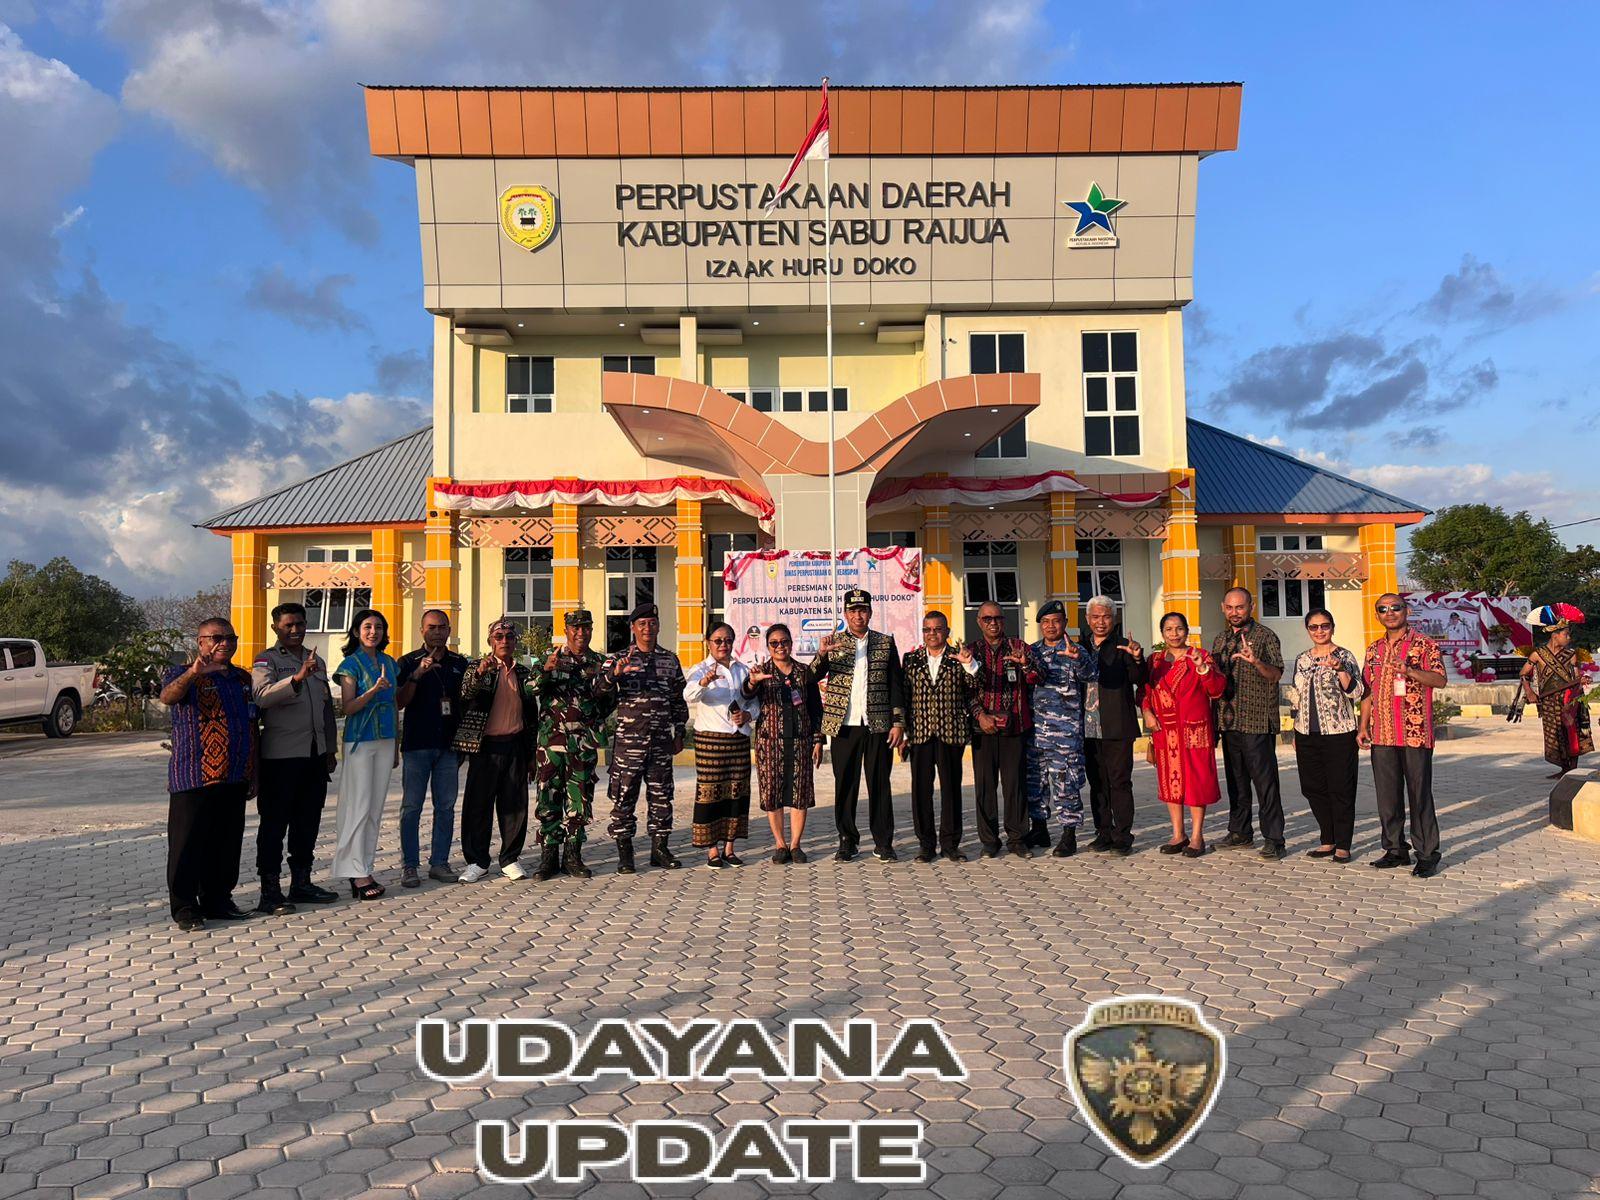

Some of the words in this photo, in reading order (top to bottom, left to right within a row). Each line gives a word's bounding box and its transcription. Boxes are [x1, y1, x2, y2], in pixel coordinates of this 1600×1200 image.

[615, 182, 870, 210] PERPUSTAKAAN
[882, 181, 1011, 209] DAERAH
[617, 220, 800, 247] KABUPATEN
[808, 218, 892, 246] SABU
[903, 217, 1010, 244] RAIJUA
[706, 258, 775, 278] IZAAK
[782, 257, 844, 277] HURU
[854, 256, 917, 275] DOKO
[732, 596, 787, 605] PERPUSTAKAAN
[813, 595, 843, 603] DAERH
[779, 607, 821, 615] KABUPATEN
